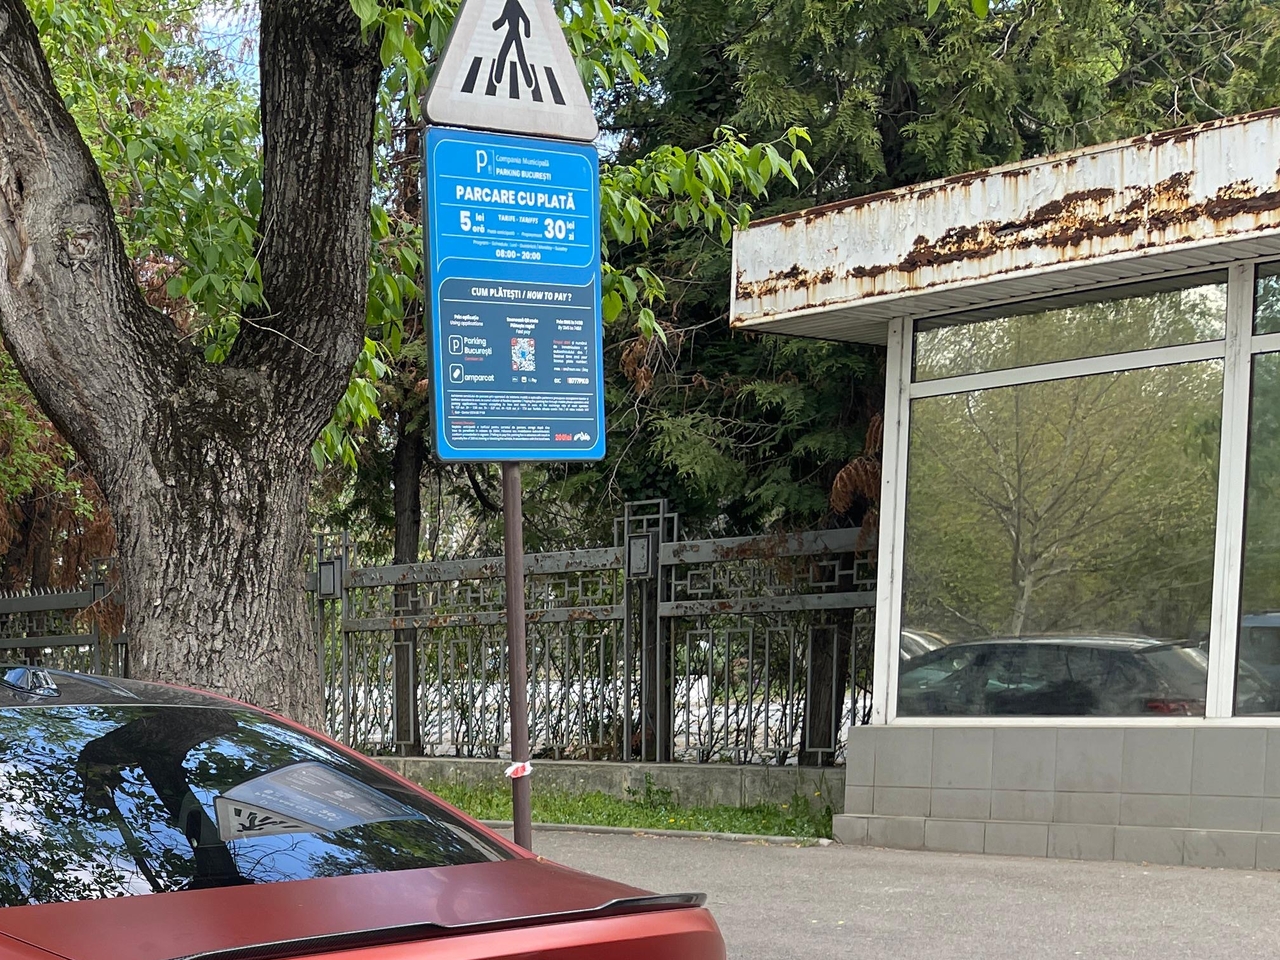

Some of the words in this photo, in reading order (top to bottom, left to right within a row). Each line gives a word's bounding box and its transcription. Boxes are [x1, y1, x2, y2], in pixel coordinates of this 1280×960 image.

[495, 167, 521, 177] PARKING
[456, 185, 516, 205] PARCARE
[517, 192, 535, 207] CU
[537, 192, 576, 210] PLATĂ
[459, 210, 472, 232] 5
[475, 212, 485, 222] lei
[498, 214, 516, 223] TARIFE
[543, 217, 567, 240] 30
[566, 220, 575, 230] lei
[495, 248, 516, 259] 08:00
[521, 251, 541, 260] 20:00
[471, 286, 489, 297] CUM
[489, 286, 522, 301] PLĂTEȘTI
[526, 291, 544, 300] HOW
[544, 291, 554, 301] TO
[554, 292, 568, 302] PAY
[464, 336, 487, 347] Parking
[464, 374, 495, 383] amparcat
